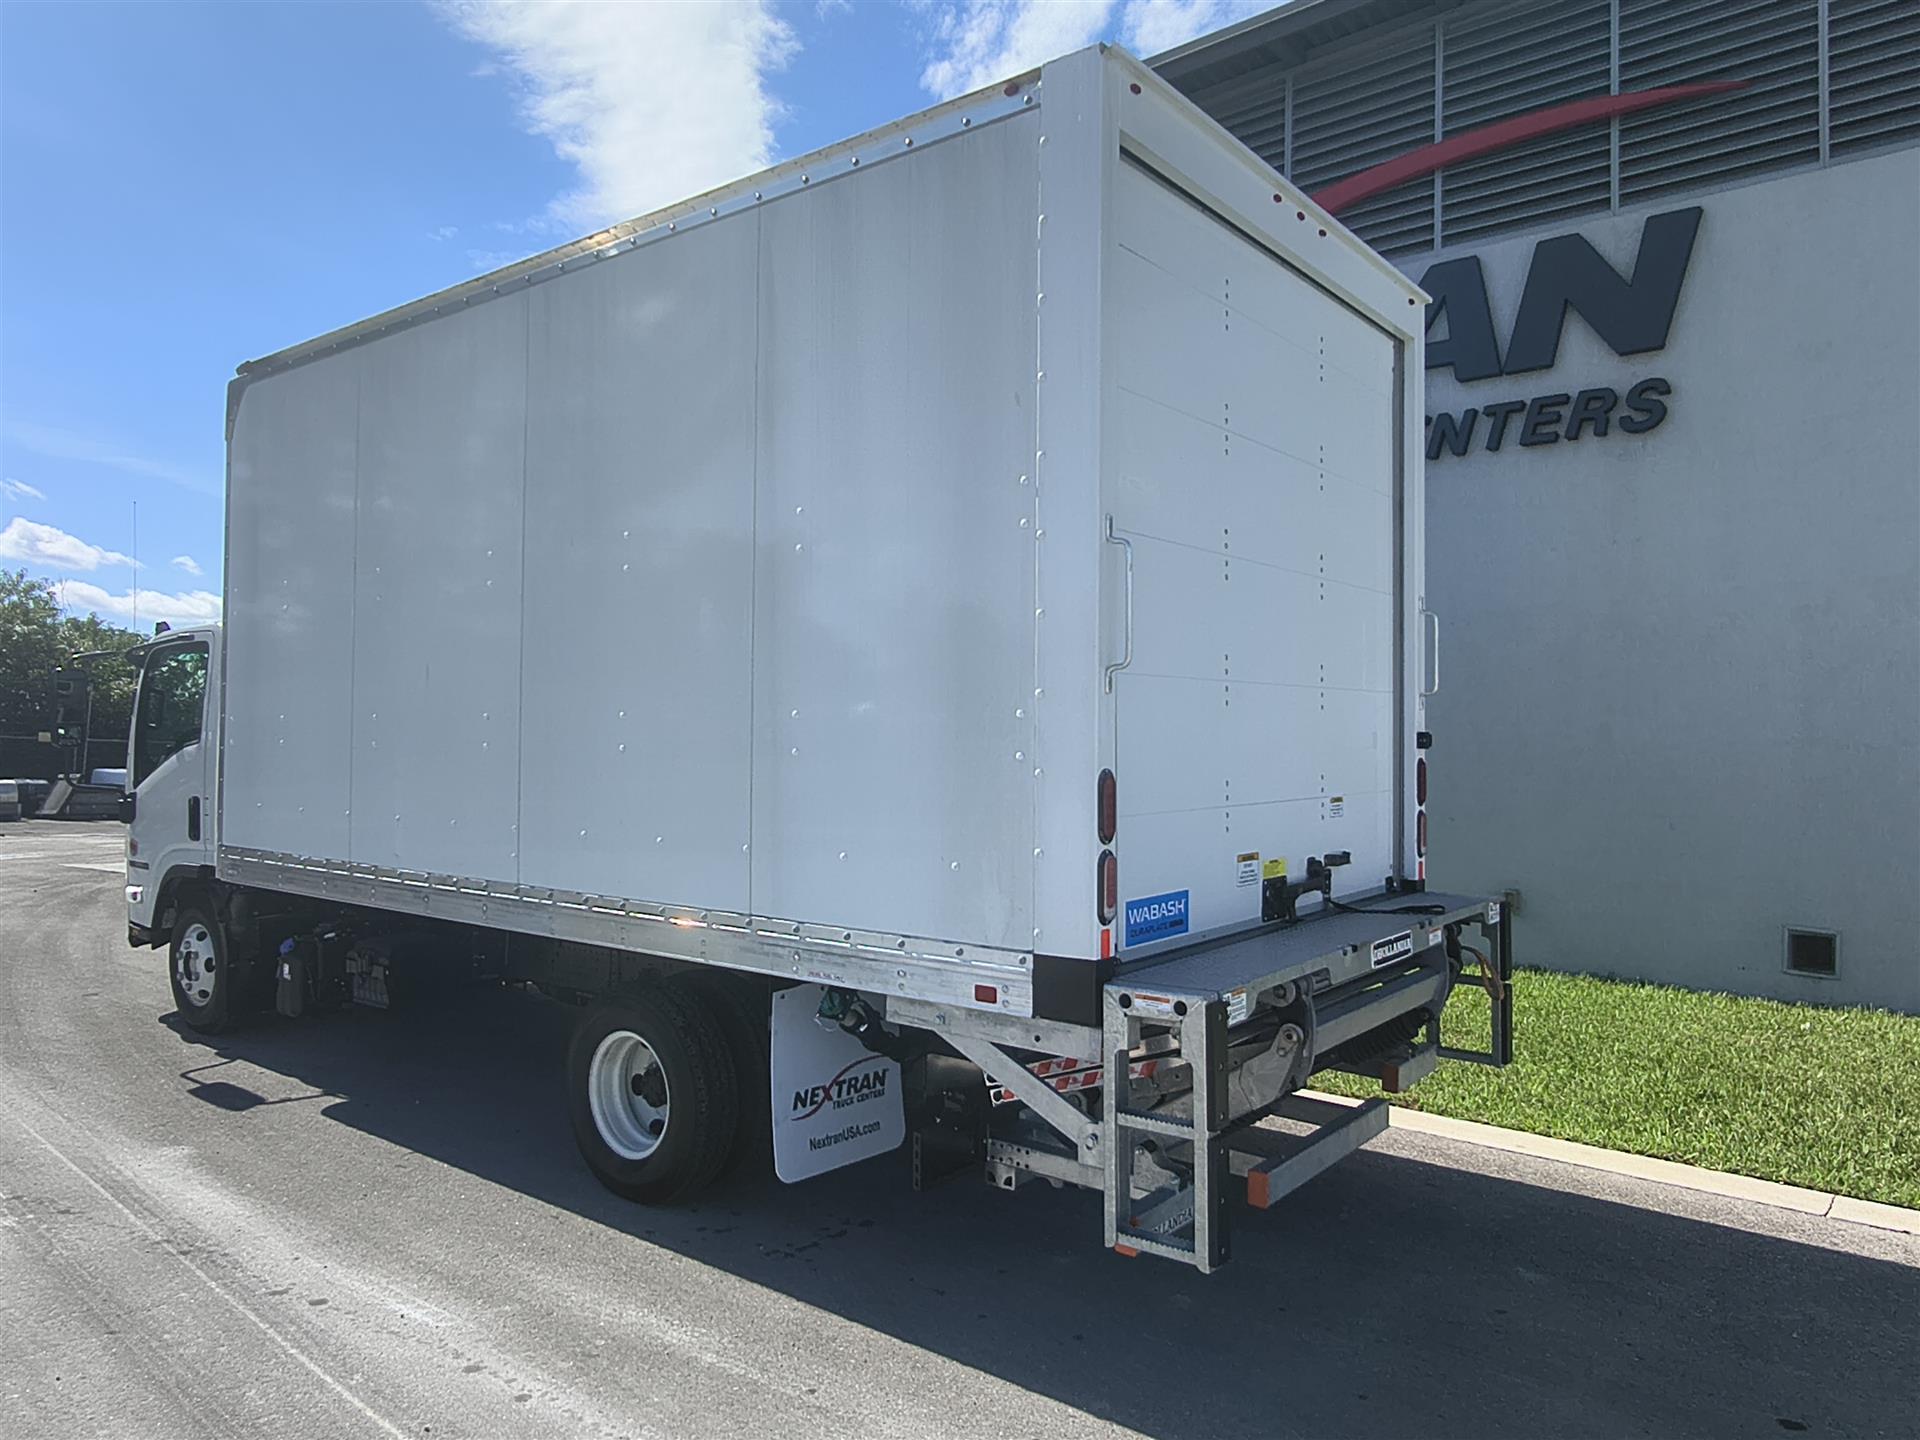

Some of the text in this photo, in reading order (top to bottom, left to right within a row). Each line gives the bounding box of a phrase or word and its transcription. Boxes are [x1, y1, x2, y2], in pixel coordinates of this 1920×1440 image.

[1425, 377, 1672, 461] NTERS
[1128, 899, 1186, 925] WABASH
[792, 1069, 887, 1111] NEXTRAN
[833, 1088, 886, 1110] TRUCK CENTERS
[809, 1121, 881, 1151] NextranUSA.com
